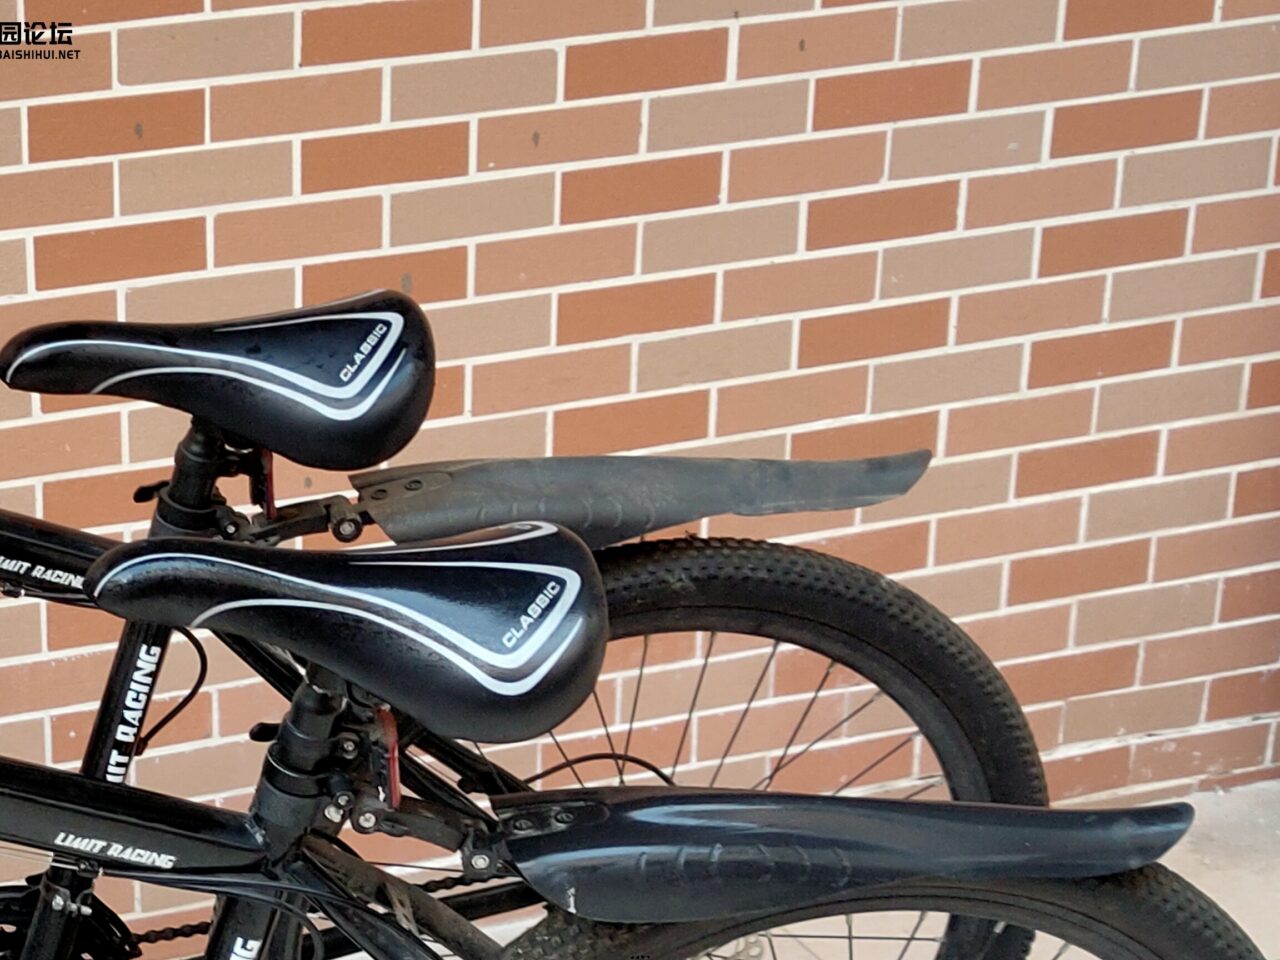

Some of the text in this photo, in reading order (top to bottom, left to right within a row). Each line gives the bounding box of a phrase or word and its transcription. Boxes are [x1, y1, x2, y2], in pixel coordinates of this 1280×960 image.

[115, 643, 162, 743] RACING
[54, 831, 177, 870] LIMIT RACING
